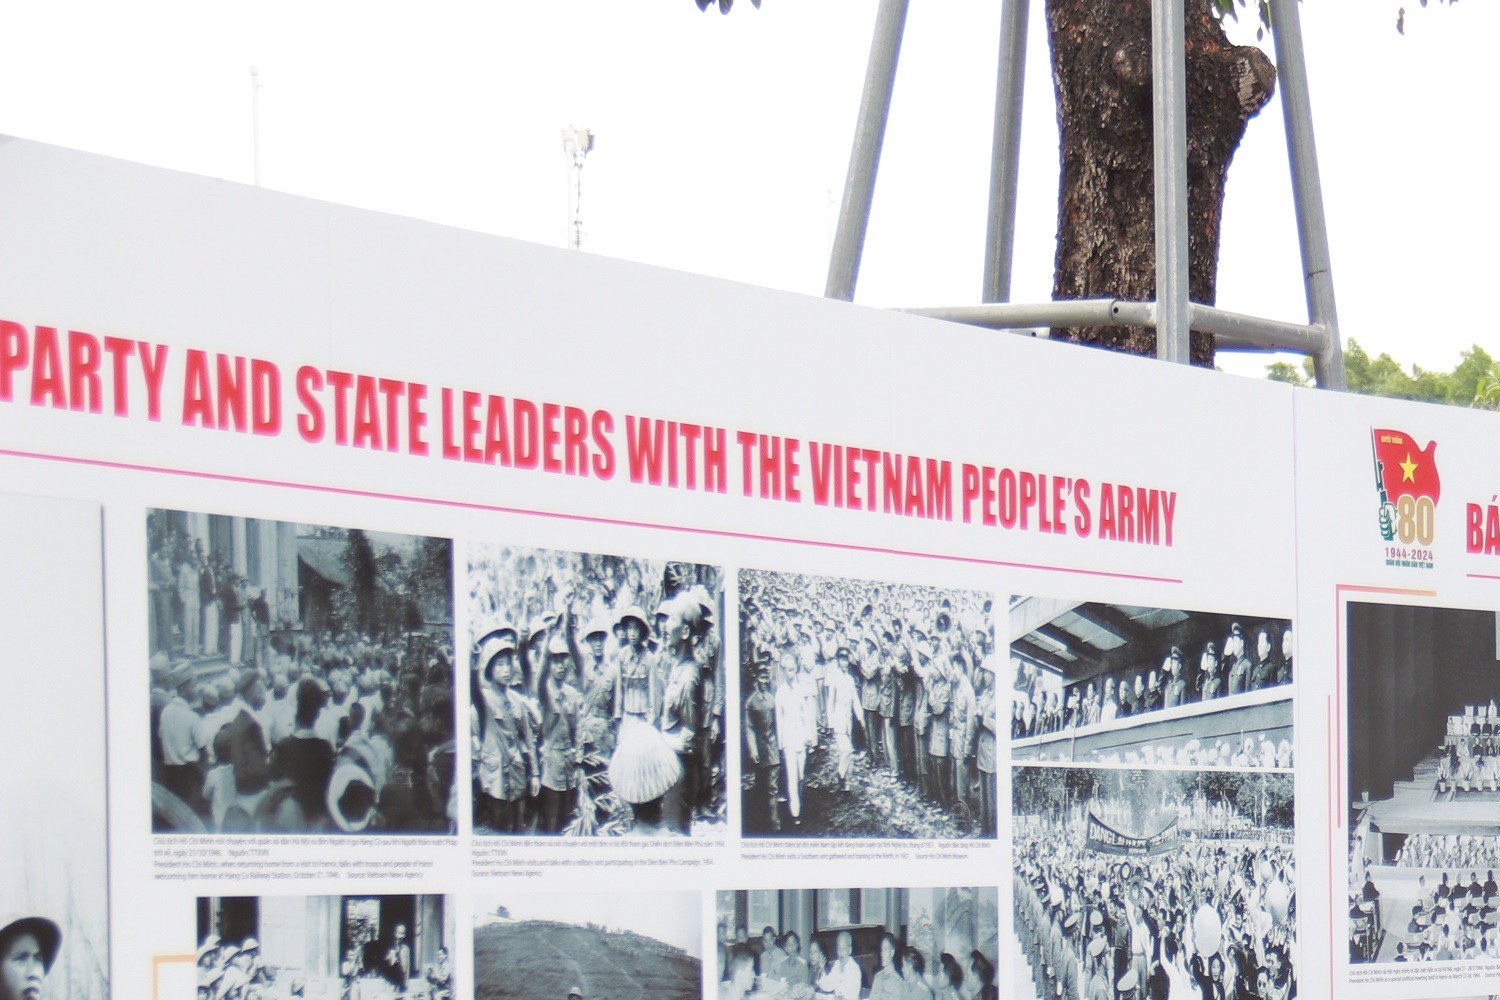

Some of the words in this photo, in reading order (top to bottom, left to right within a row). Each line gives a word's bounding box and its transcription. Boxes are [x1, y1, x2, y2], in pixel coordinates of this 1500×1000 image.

[0, 320, 167, 420] PARTY
[183, 349, 280, 435] AND
[297, 366, 428, 455] STATE
[442, 388, 615, 479] LEADERS
[626, 416, 726, 492] WITH
[738, 432, 800, 501] THE
[810, 442, 952, 519] VIETNAM
[1099, 483, 1176, 544] ARMY
[1398, 495, 1435, 546] 80
[1385, 547, 1433, 561] 1944-2024
